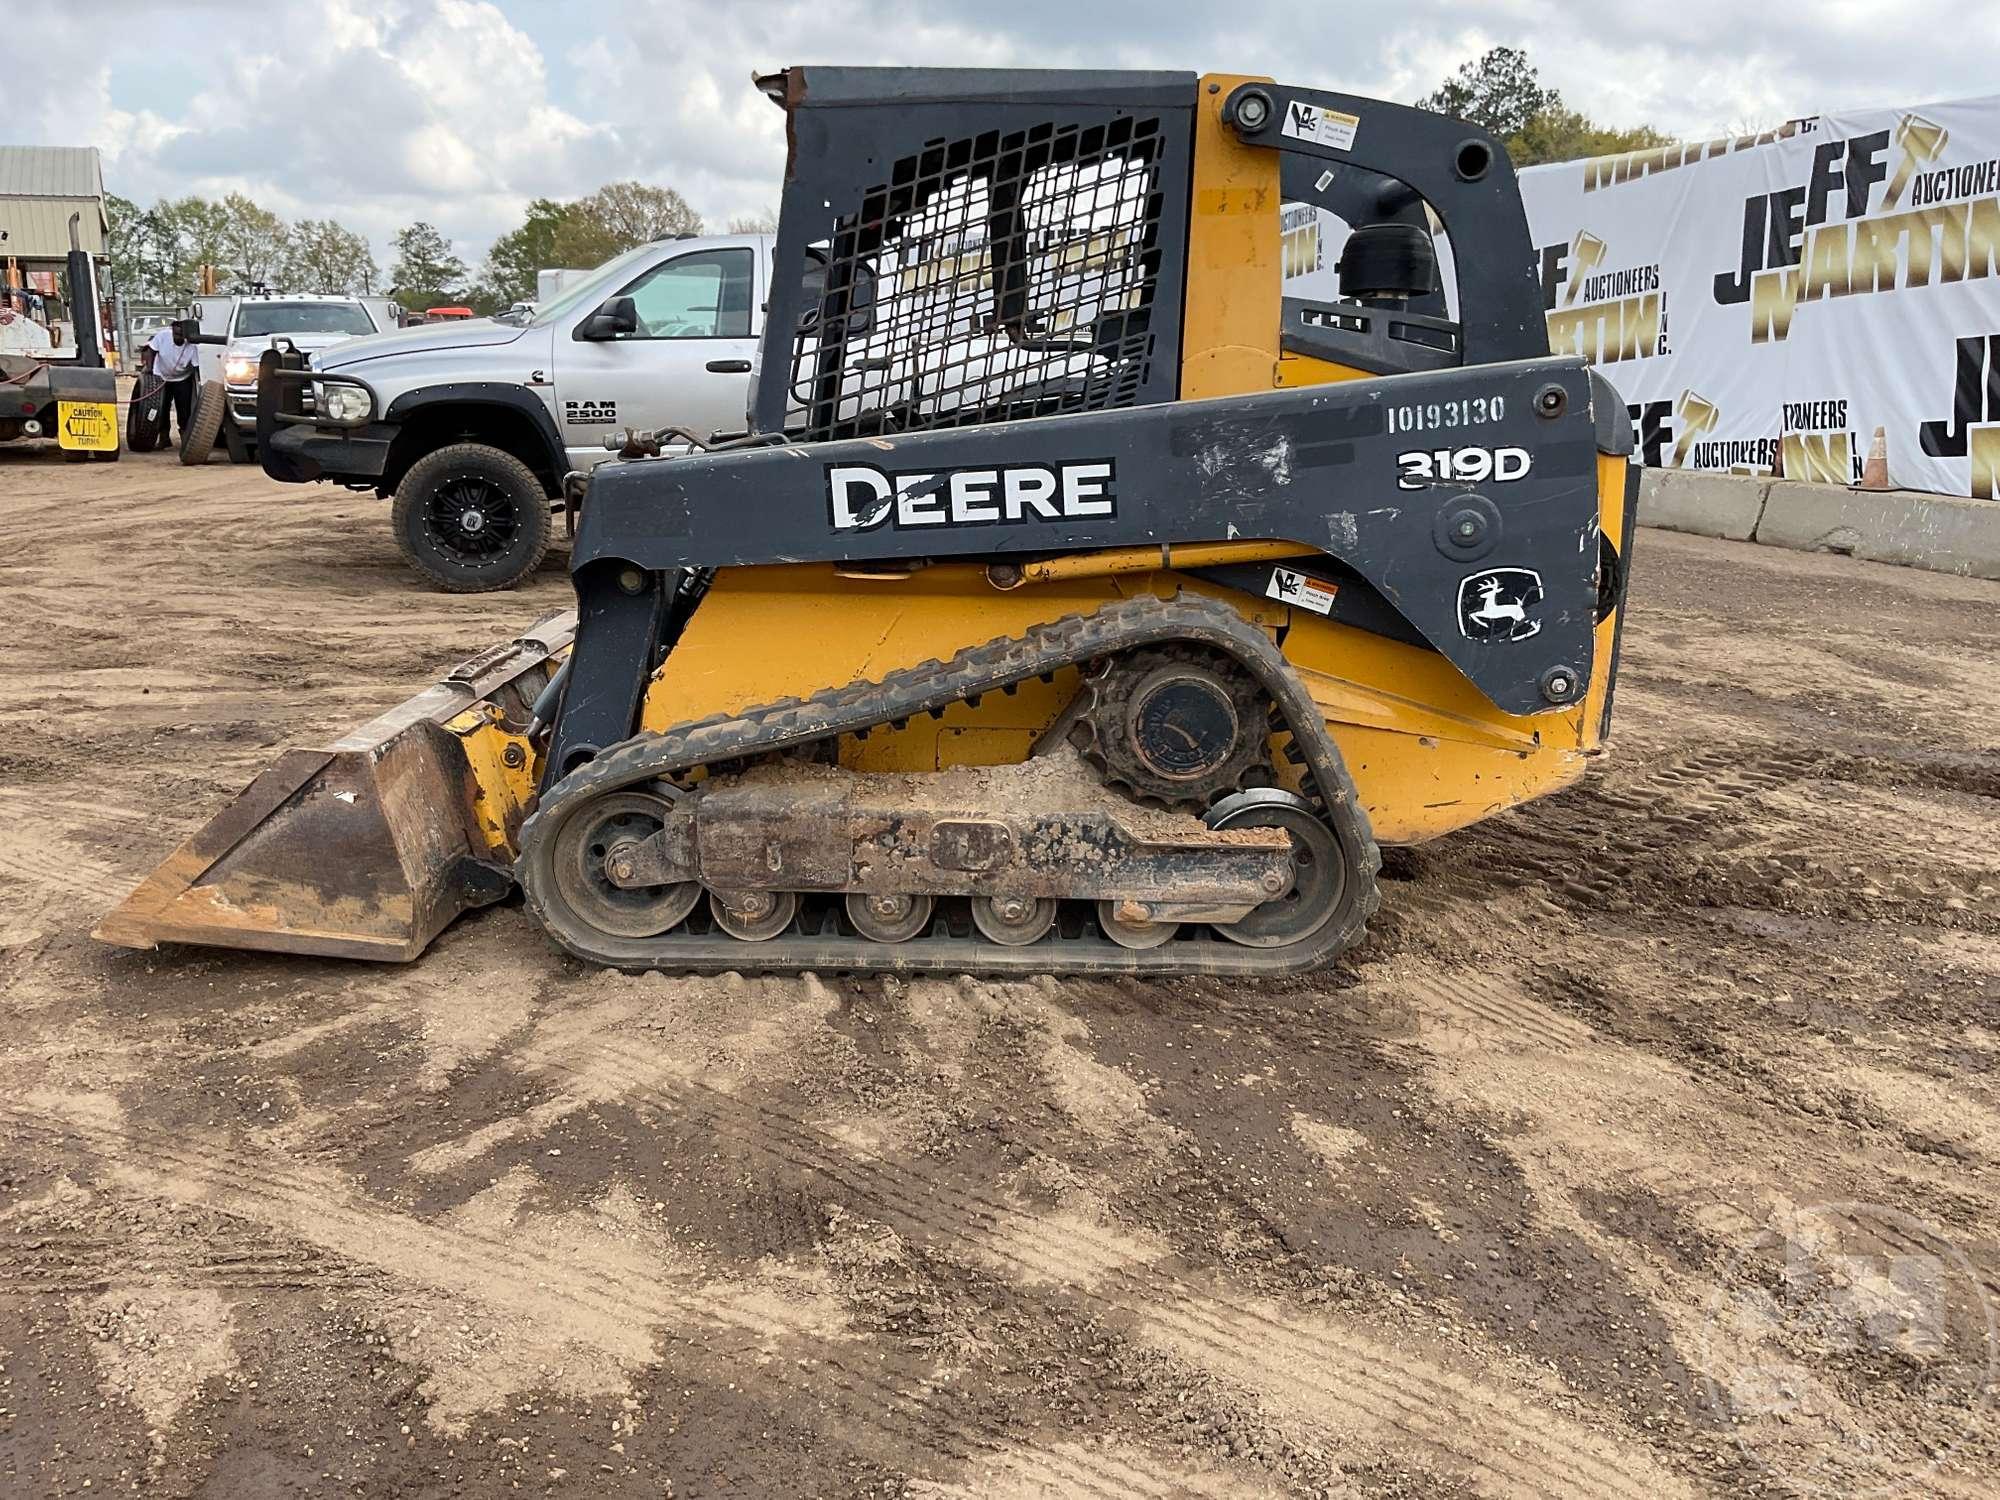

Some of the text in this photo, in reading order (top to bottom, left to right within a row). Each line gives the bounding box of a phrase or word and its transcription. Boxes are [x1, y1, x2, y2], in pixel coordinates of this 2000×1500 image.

[1713, 129, 1890, 304] JEFF
[1583, 264, 1660, 302] AUCTIONEERS
[1657, 291, 1672, 356] INC.
[73, 408, 103, 418] CAUTION
[565, 401, 616, 409] RAM
[566, 410, 616, 418] 2500
[1388, 396, 1504, 434] 10193130
[1398, 447, 1531, 489] 319D
[830, 463, 1113, 529] DEERE
